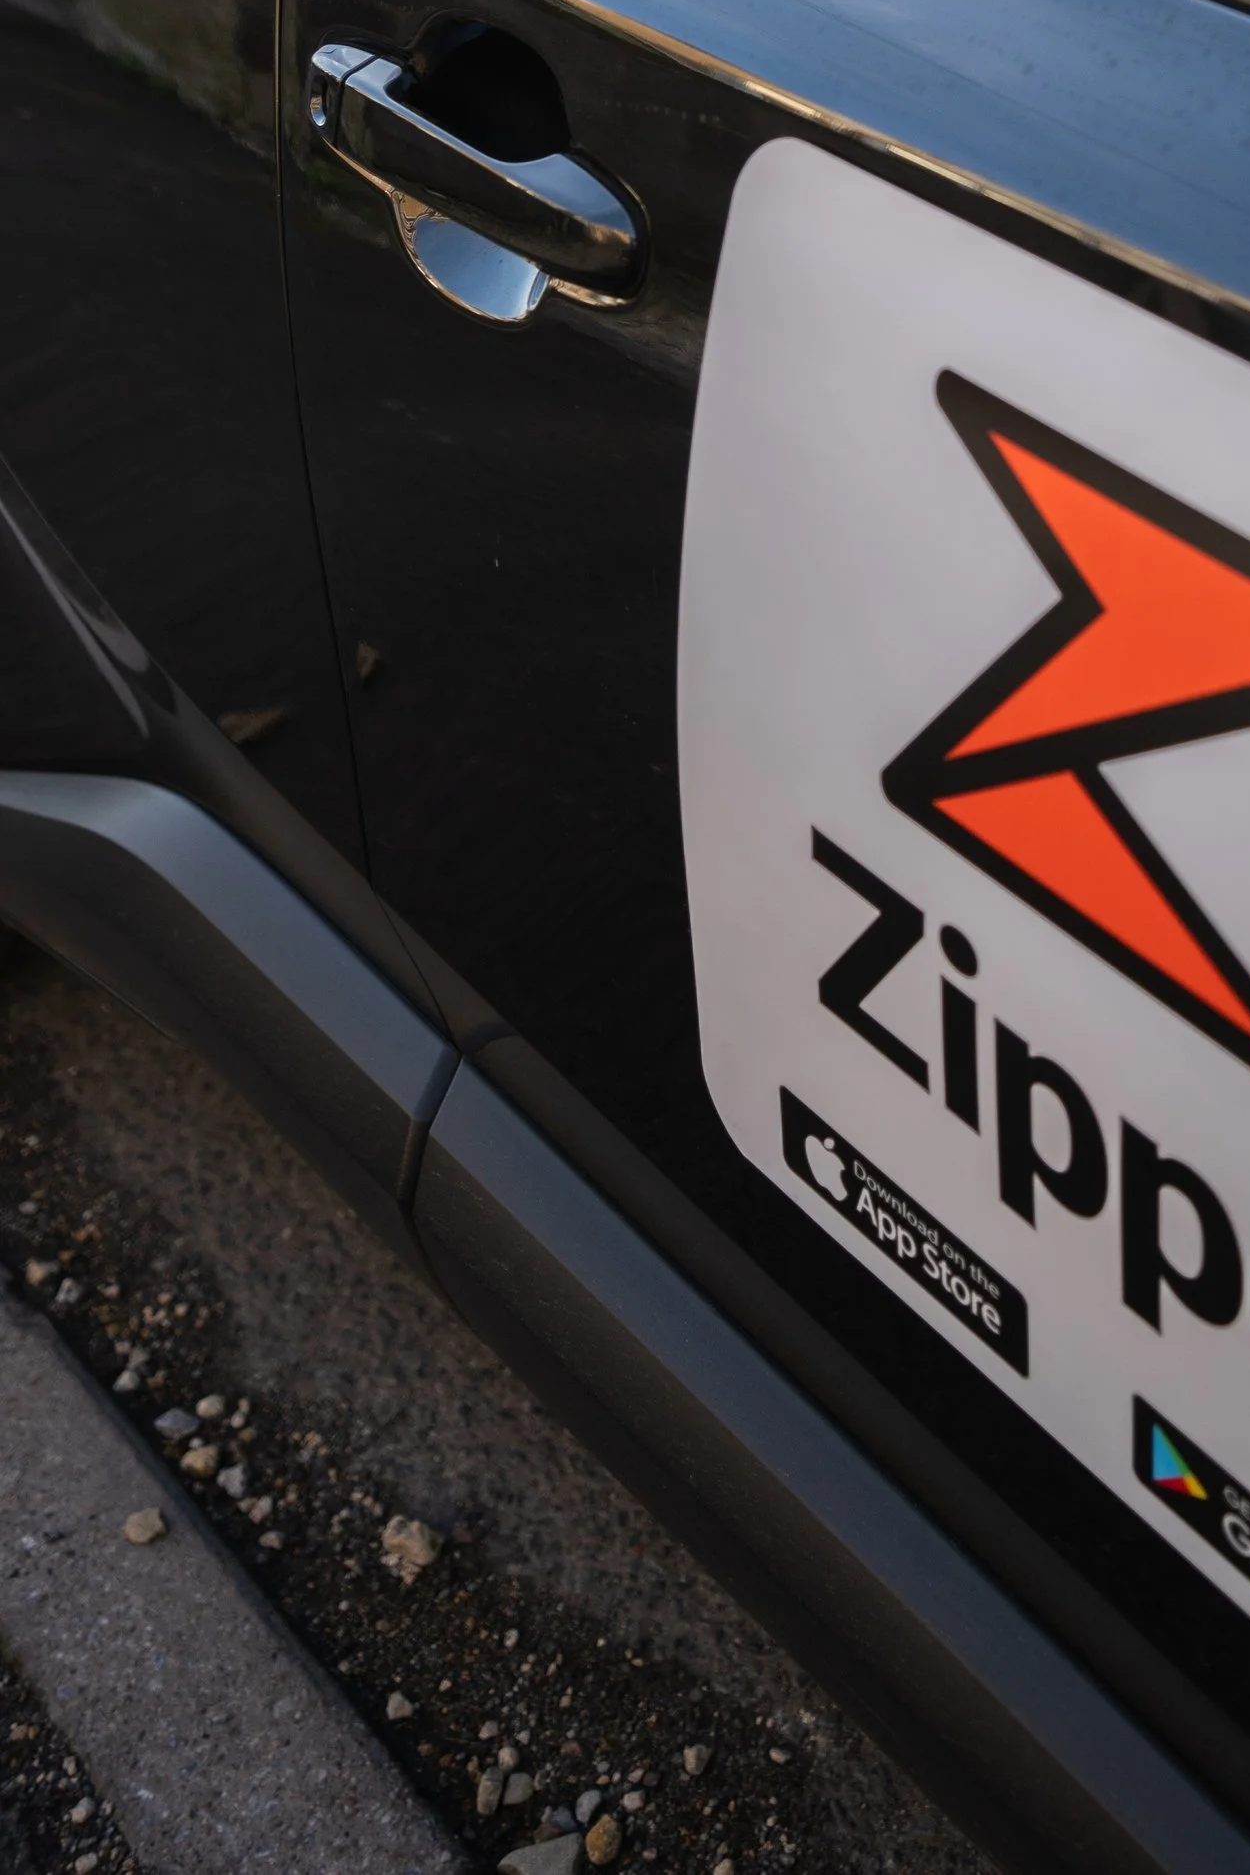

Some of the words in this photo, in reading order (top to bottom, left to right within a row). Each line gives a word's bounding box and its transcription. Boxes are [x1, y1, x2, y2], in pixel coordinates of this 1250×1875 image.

[854, 1161, 939, 1246] Download
[942, 1243, 966, 1270] on
[970, 1264, 999, 1300] the
[856, 1187, 917, 1258] App
[922, 1243, 1001, 1335] Store
